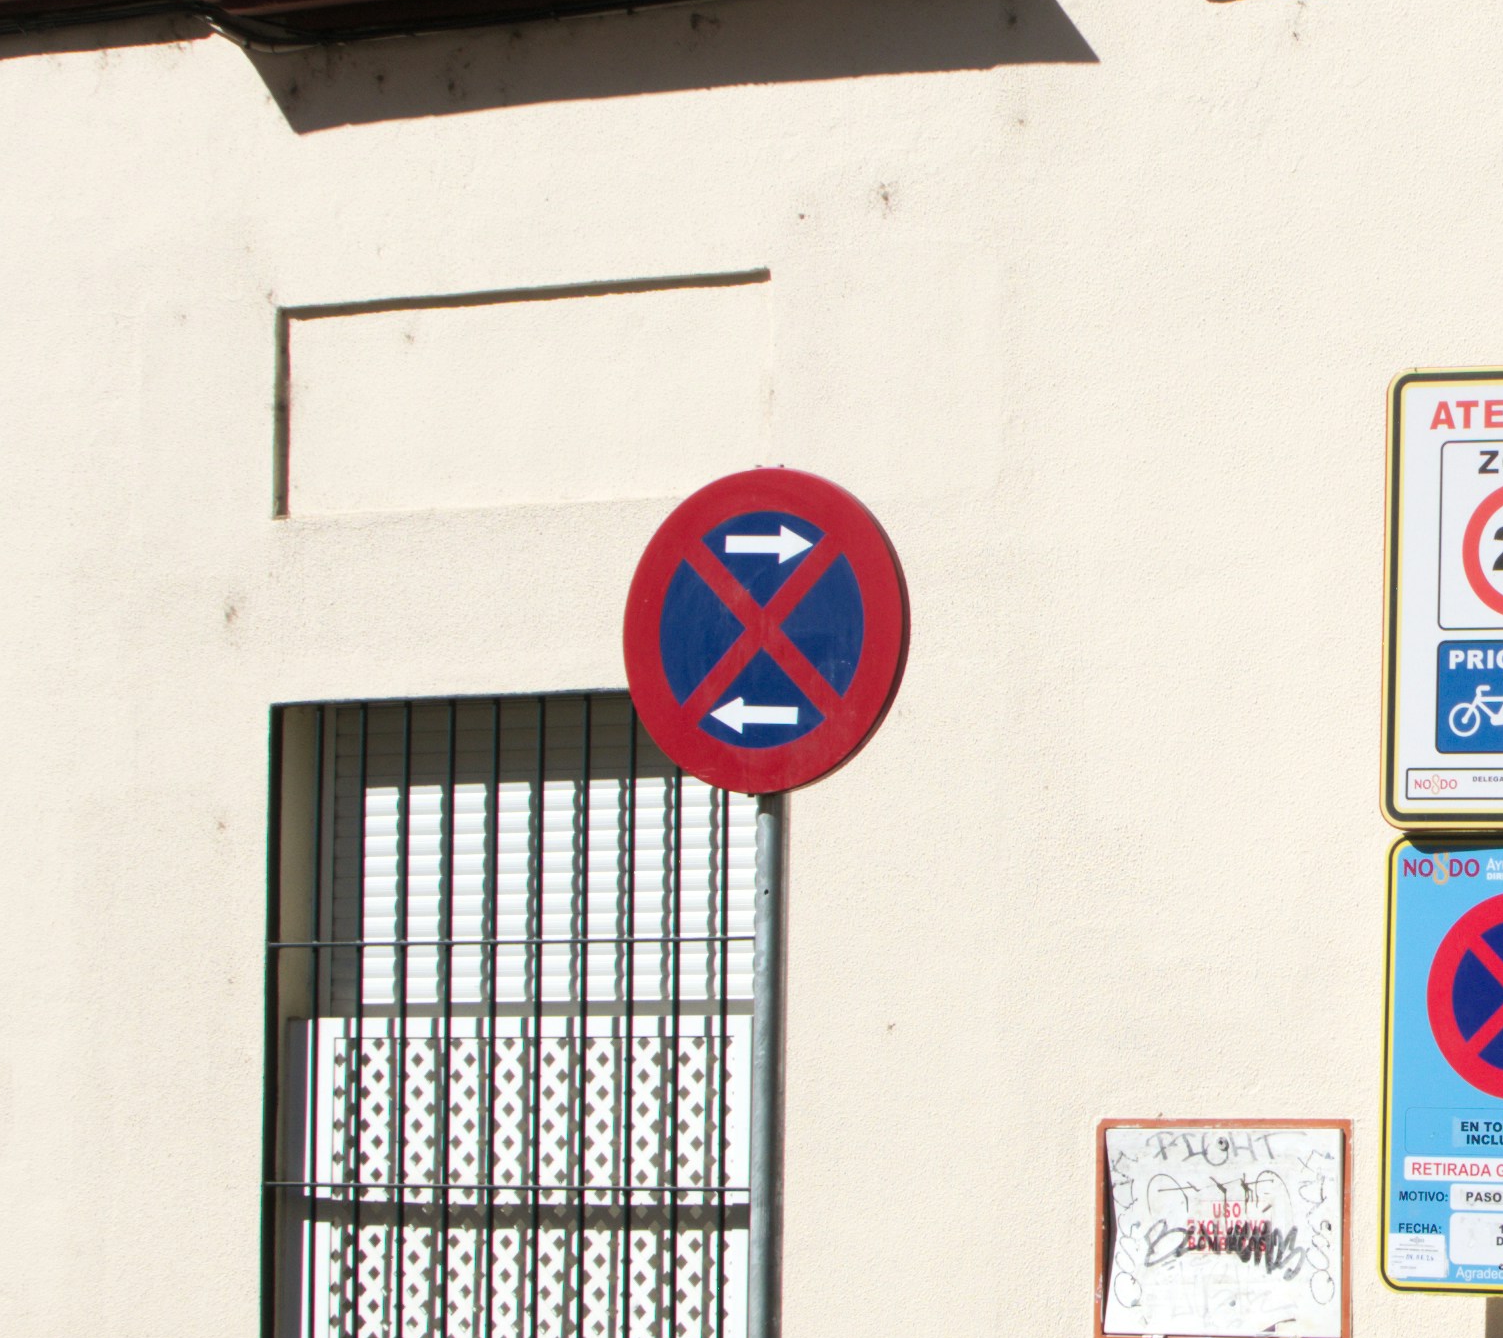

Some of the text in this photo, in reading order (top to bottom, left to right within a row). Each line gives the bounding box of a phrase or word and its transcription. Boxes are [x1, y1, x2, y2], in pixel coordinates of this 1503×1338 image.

[1460, 1121, 1481, 1132] EN
[1411, 1161, 1492, 1177] RETIRADA
[1398, 1190, 1449, 1203] MOTIVO:
[1465, 1191, 1502, 1203] PASO
[1212, 1202, 1241, 1218] USO
[1187, 1219, 1269, 1235] EXCLUSVO
[1398, 1223, 1442, 1234] FECHA:
